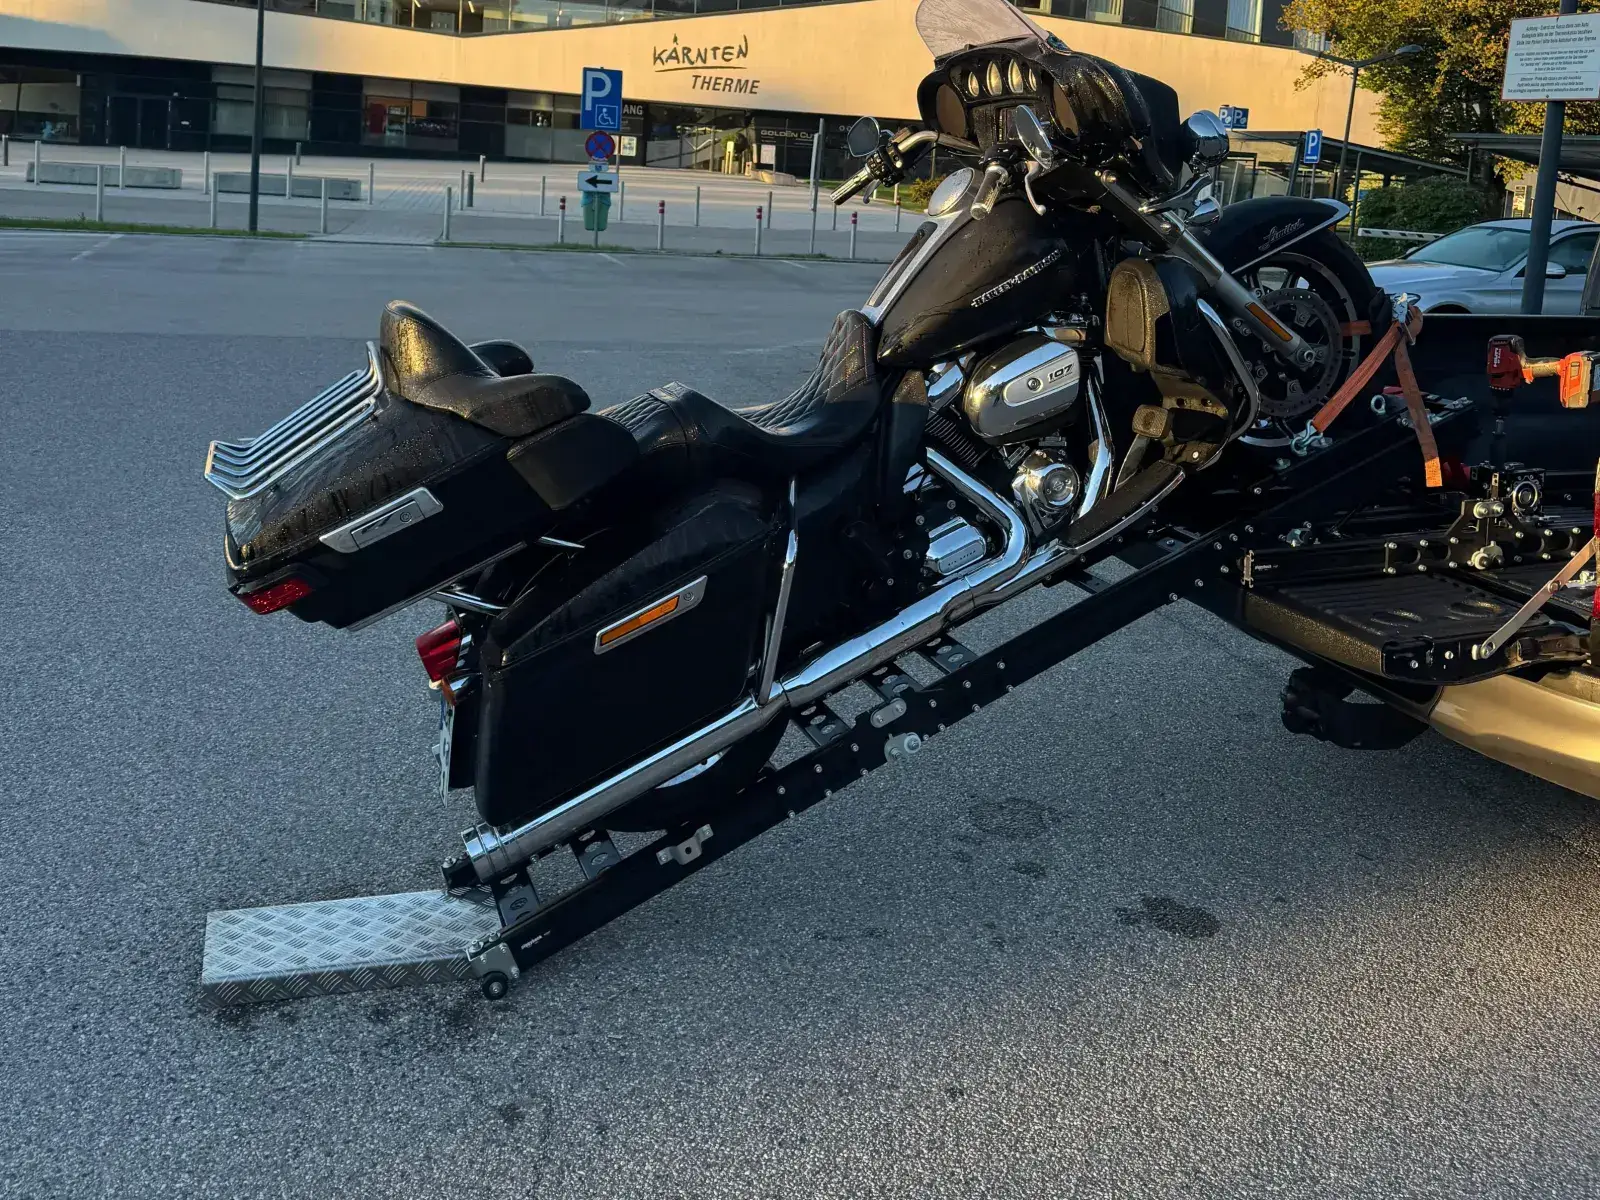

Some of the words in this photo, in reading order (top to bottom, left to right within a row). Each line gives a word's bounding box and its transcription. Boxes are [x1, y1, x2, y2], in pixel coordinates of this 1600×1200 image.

[585, 71, 612, 111] P
[692, 74, 761, 94] THERME
[1220, 109, 1228, 122] P
[1234, 109, 1243, 123] P
[760, 129, 798, 138] GOLDEN
[1307, 132, 1318, 154] P
[1048, 362, 1075, 381] 107
